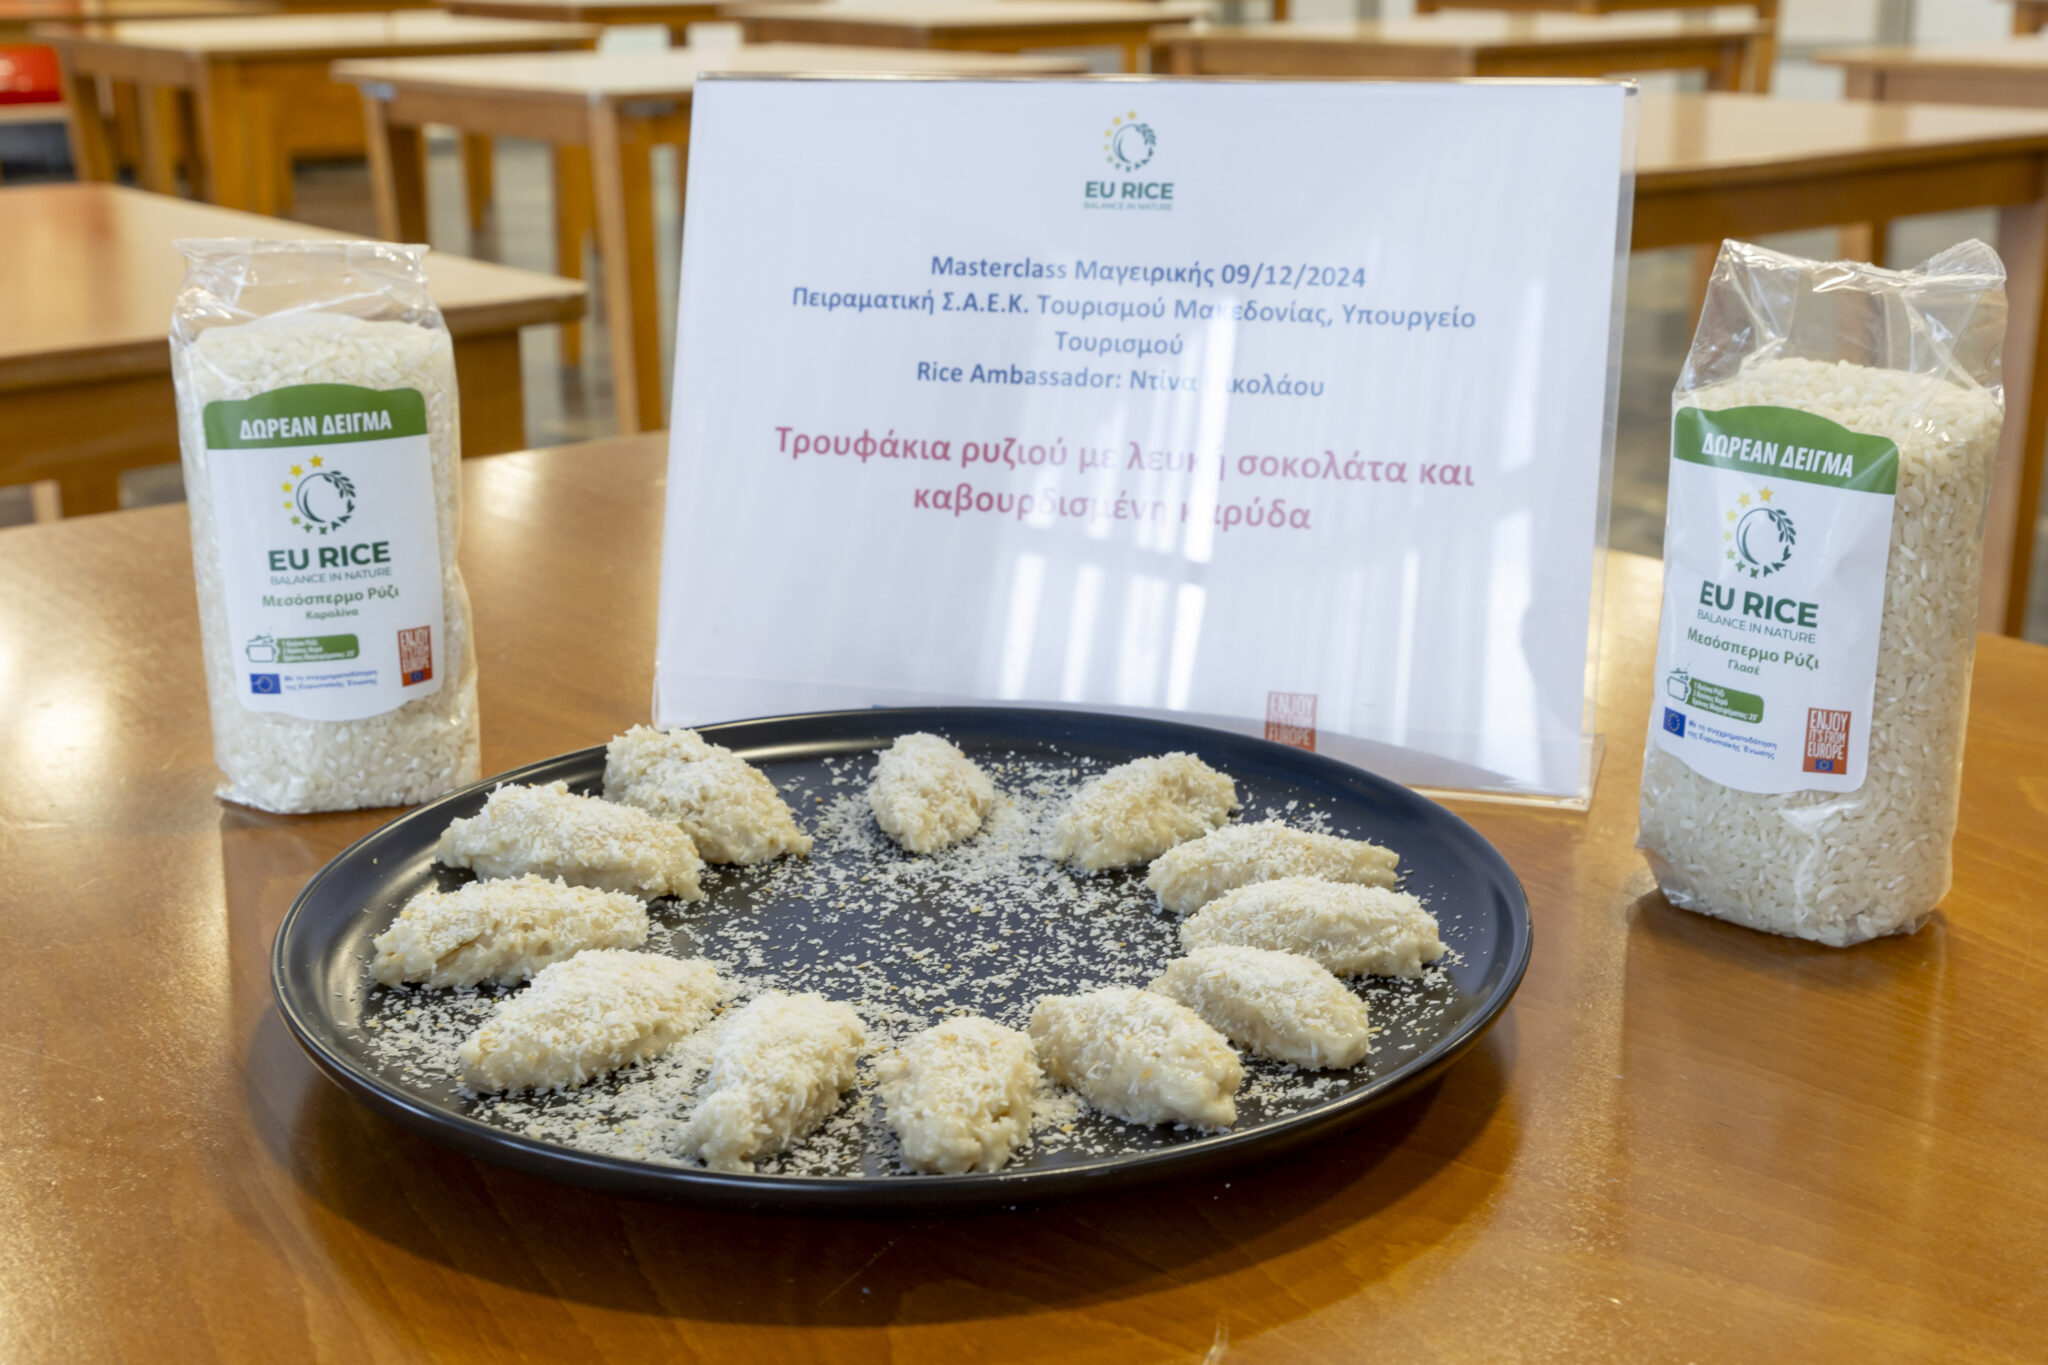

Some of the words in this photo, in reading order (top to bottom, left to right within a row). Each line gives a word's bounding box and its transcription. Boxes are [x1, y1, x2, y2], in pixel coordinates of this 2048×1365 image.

[1085, 181, 1115, 198] EU
[1121, 182, 1174, 199] RICE
[931, 256, 1067, 279] Masterclass
[1075, 260, 1215, 288] Μαγειρικής
[1221, 262, 1366, 289] 09/12/2024
[792, 287, 934, 315] Πειραματική
[942, 292, 1028, 313] Σ.Α.Ε.Κ.
[1037, 295, 1166, 323] Τουρισμού
[1342, 304, 1476, 331] Υπουργείο
[1055, 331, 1183, 358] Τουρισμού
[917, 361, 963, 382] Rice
[970, 364, 1122, 388] Ambassador:
[1130, 370, 1198, 392] Ντίνα
[1208, 373, 1325, 397] ικολάου
[240, 416, 318, 440] ΔΩΡΕΑΝ
[322, 409, 393, 435] ΔΕΙΓΜΑ
[775, 427, 951, 464] Τρουφάκια
[961, 437, 1067, 470] ρυζιού
[1079, 447, 1118, 473] με
[1238, 450, 1407, 483] σοκολάτα
[1420, 462, 1475, 486] και
[1701, 432, 1779, 466] ΔΩΡΕΑΝ
[1779, 445, 1854, 478] ΔΕΙΓΜΑ
[1180, 496, 1311, 532] ρύδα
[268, 548, 310, 571] EU
[318, 541, 391, 568] RICE
[270, 574, 326, 585] BALANCE
[329, 572, 342, 582] IN
[345, 567, 392, 580] NATURE
[262, 591, 364, 607] Μεσόσπερμο
[368, 584, 399, 600] Ρύζι
[1699, 580, 1736, 611] EU
[1743, 590, 1819, 628] RICE
[1697, 609, 1746, 631] BALANCE
[1749, 622, 1762, 634] IN
[1764, 626, 1816, 644] NATURE
[1687, 626, 1779, 663] Μεσόσπερμο
[1784, 651, 1819, 671] Ρύζι
[1728, 659, 1760, 675] Γλασέ
[1810, 710, 1848, 732] ENJOY
[1808, 741, 1844, 760] EUROPE
[1809, 729, 1823, 743] IT'S
[1824, 730, 1846, 746] FROM
